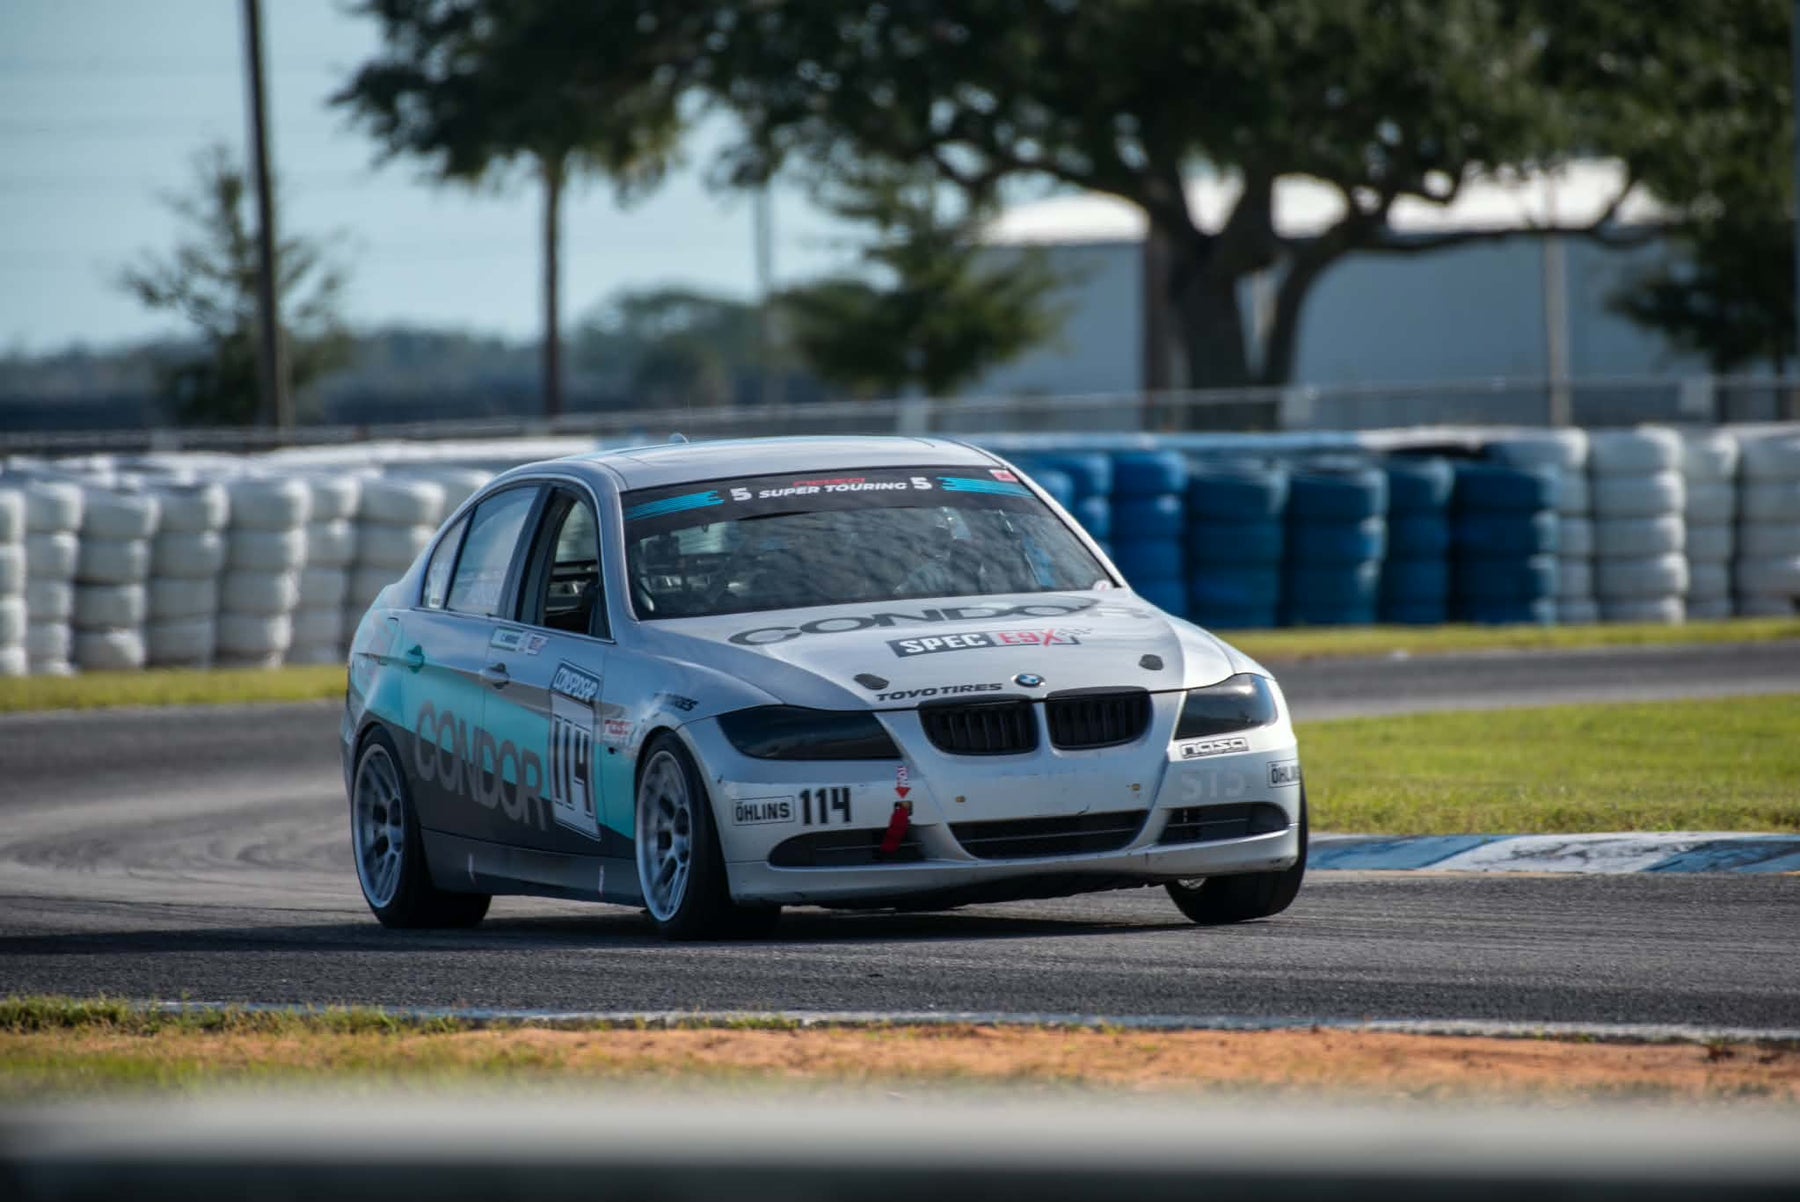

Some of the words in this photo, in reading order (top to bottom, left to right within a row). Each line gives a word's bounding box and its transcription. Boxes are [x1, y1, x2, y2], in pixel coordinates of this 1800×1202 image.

[731, 488, 752, 502] 5
[758, 485, 819, 500] SUPER
[825, 481, 907, 494] TOURING
[910, 477, 932, 490] 5
[899, 634, 988, 655] SPEC
[876, 690, 937, 702] TOYO
[940, 682, 1003, 695] TIRES
[416, 701, 547, 830] CONDOR
[553, 716, 595, 818] 114
[735, 801, 791, 823] ÖHLINS
[799, 786, 852, 825] 114
